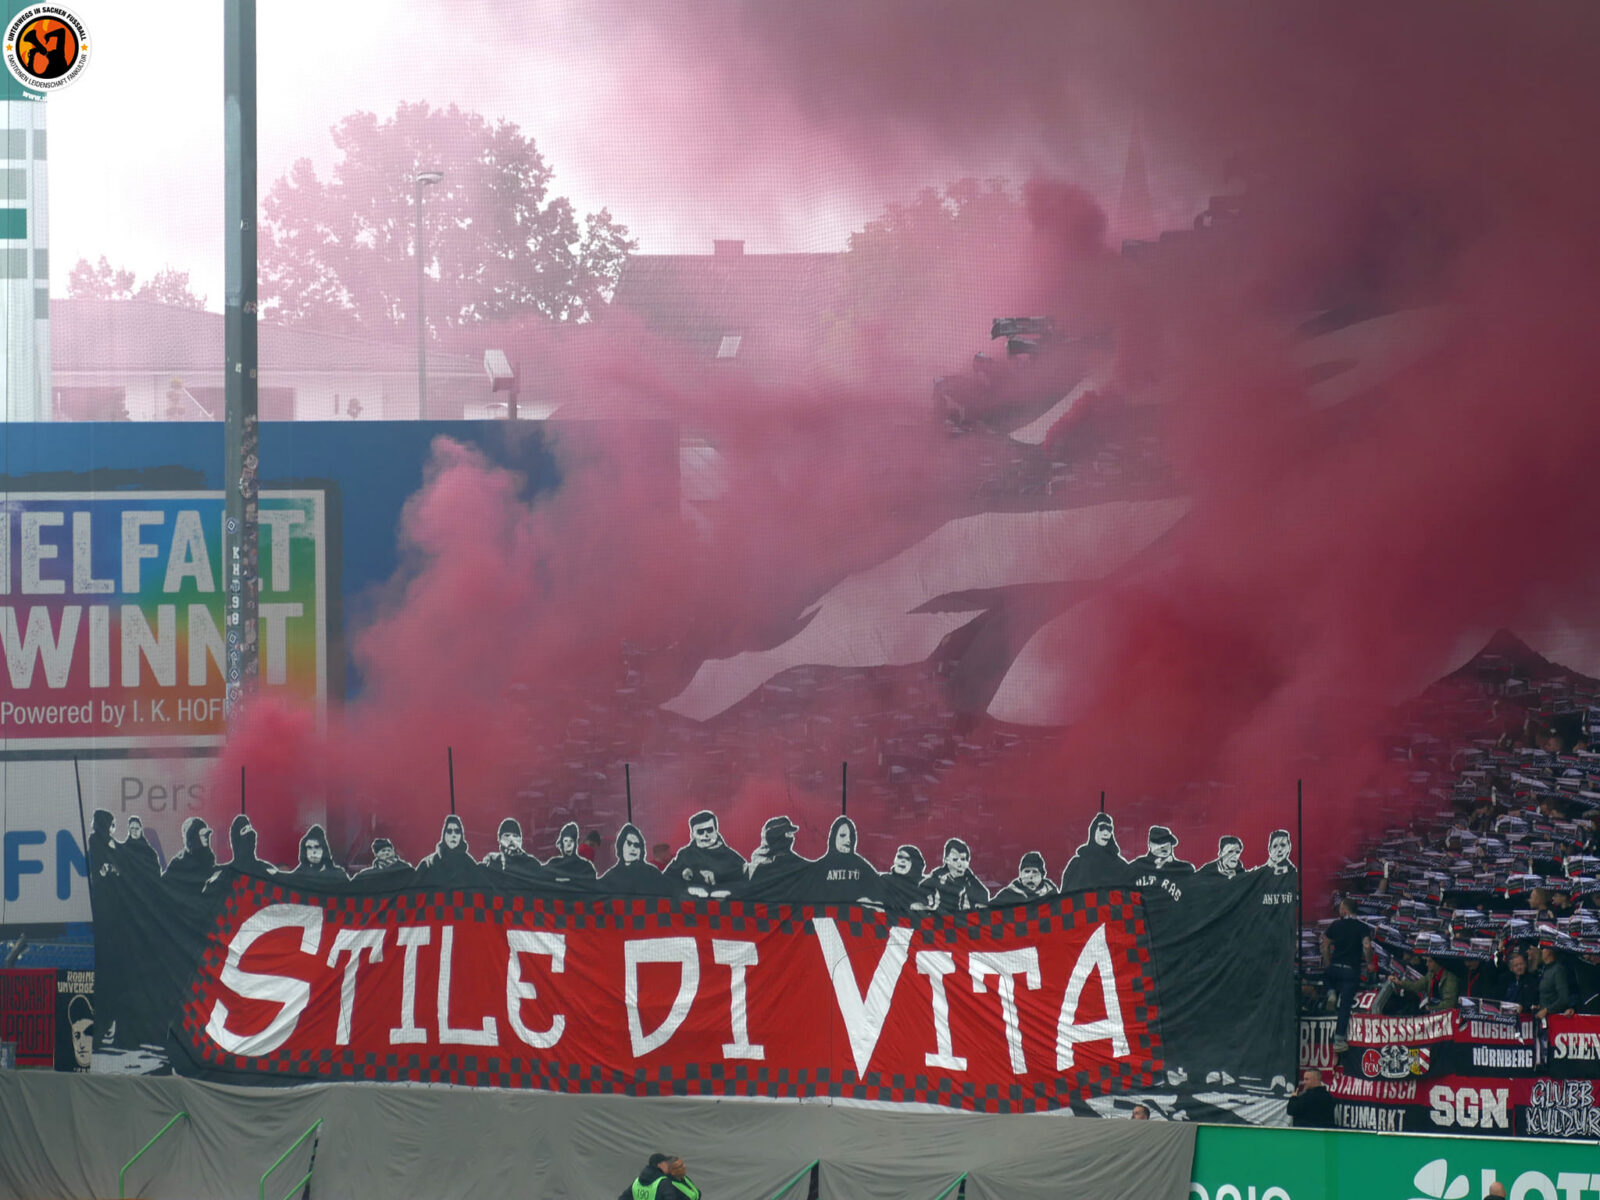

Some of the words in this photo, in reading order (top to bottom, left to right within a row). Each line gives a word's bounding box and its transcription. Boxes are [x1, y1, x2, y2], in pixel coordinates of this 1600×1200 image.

[1, 701, 93, 725] Powered
[101, 700, 126, 727] by
[151, 699, 171, 721] K.
[178, 697, 227, 721] HOF
[205, 903, 566, 1057] STILE
[624, 936, 765, 1058] DI
[812, 917, 1131, 1081] VITA
[1364, 1011, 1453, 1044] BESESSENEN
[1472, 1045, 1533, 1068] NÜRNBERG
[1429, 1085, 1509, 1129] SGN
[1530, 1079, 1595, 1109] GLUBB
[1333, 1103, 1407, 1132] NEUMARKT
